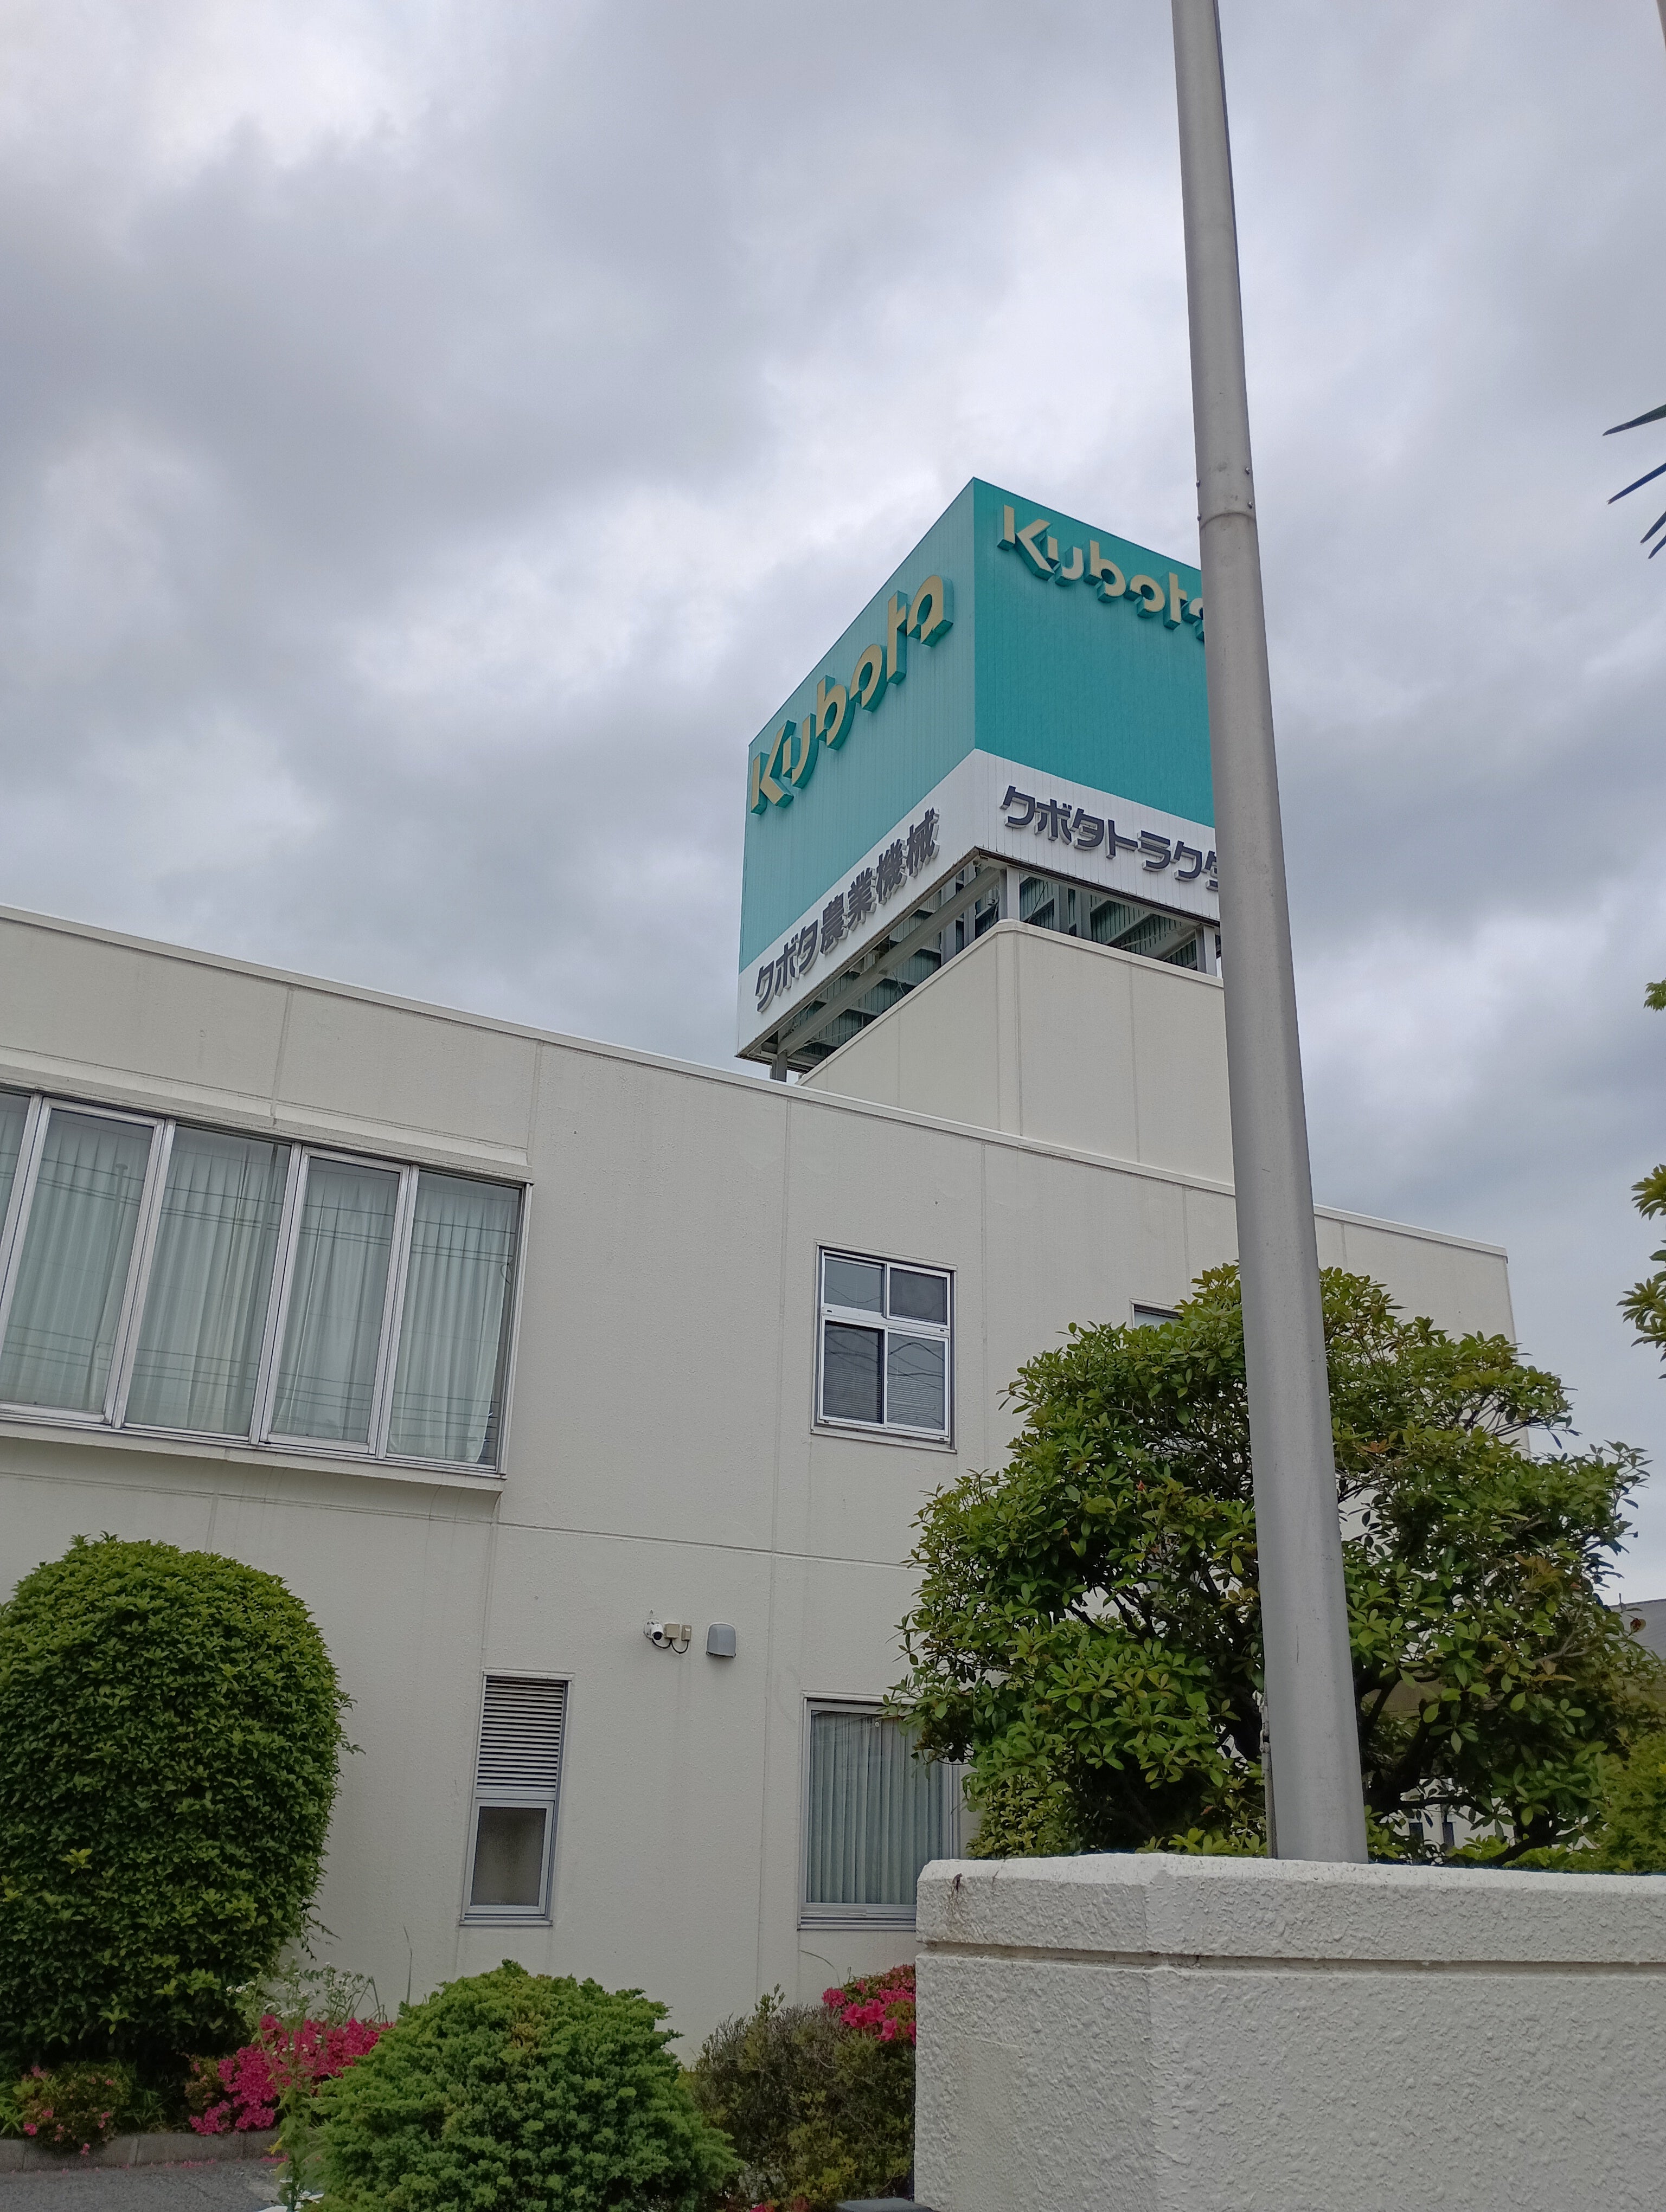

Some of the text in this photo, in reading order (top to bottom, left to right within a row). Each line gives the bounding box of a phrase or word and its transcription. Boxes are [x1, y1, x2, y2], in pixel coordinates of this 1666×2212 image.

[751, 575, 949, 814] Kubota
[755, 807, 939, 1012] クボタ農業機械
